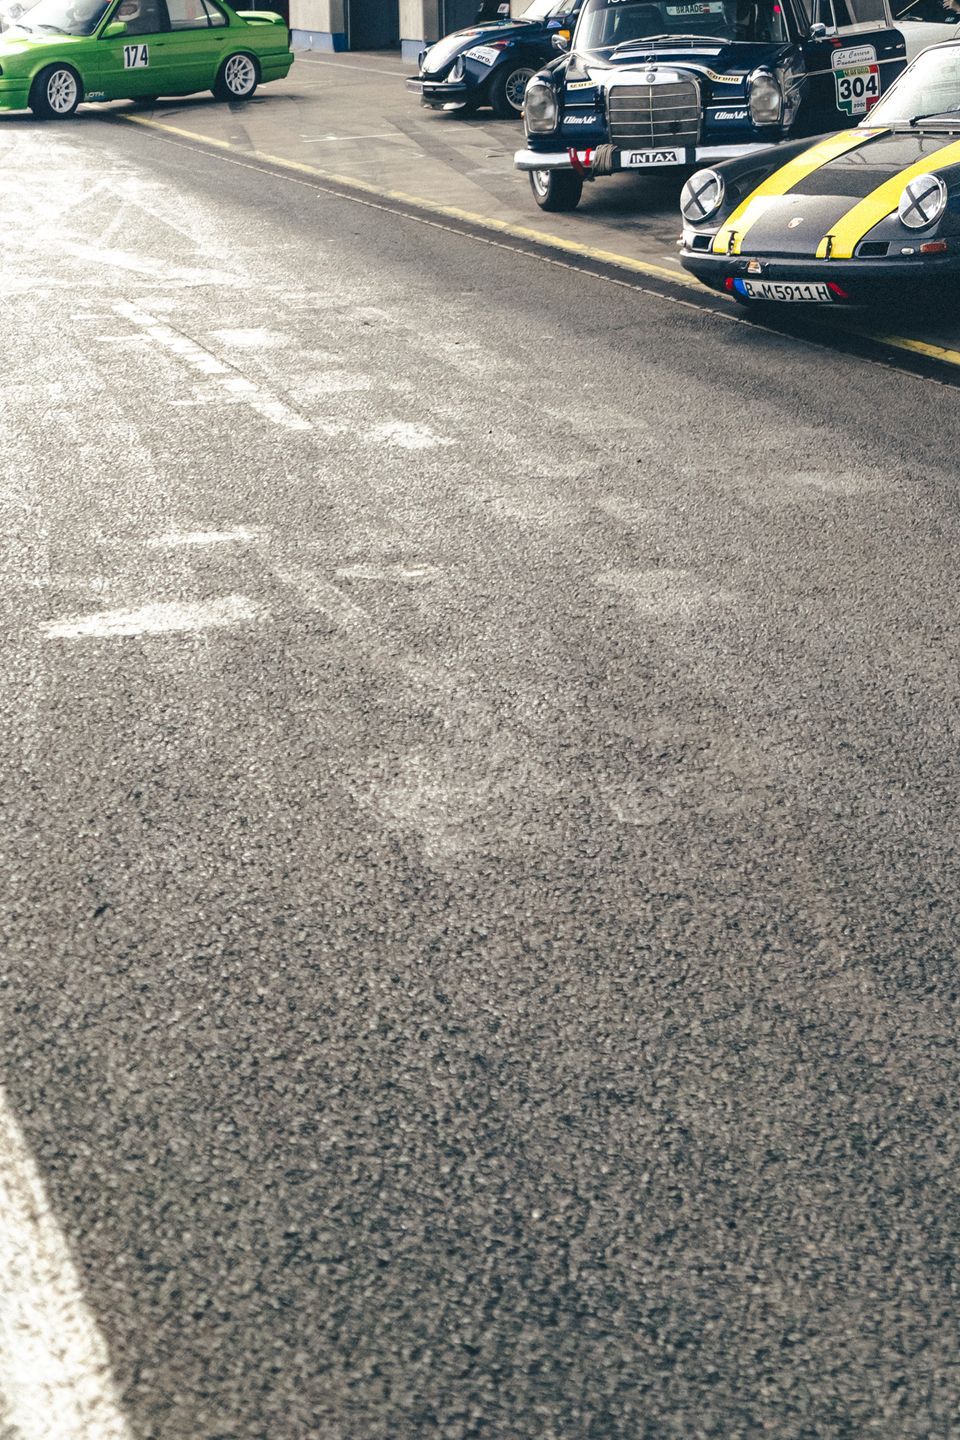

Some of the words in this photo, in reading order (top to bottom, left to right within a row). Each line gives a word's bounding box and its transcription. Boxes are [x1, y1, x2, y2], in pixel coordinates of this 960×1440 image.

[124, 44, 148, 68] 174
[840, 75, 877, 100] 304
[630, 151, 676, 164] INTAX
